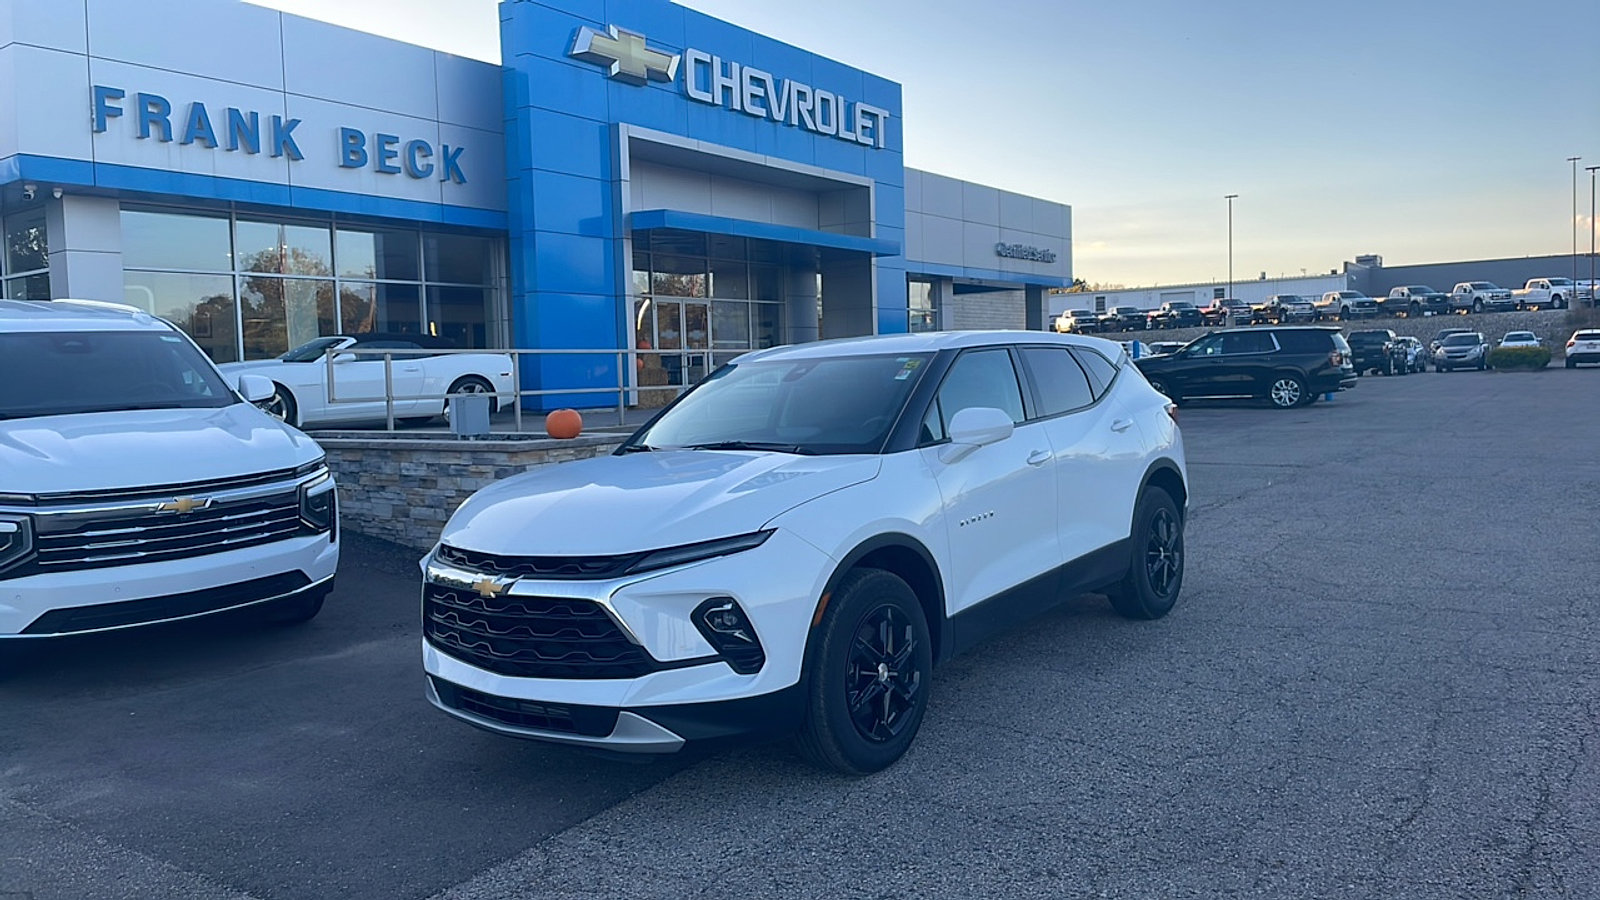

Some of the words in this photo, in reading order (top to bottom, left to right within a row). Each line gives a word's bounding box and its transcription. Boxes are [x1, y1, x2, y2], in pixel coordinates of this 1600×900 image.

[91, 84, 305, 161] FRANK
[338, 126, 467, 185] BECK
[685, 47, 890, 149] CHEVROLET
